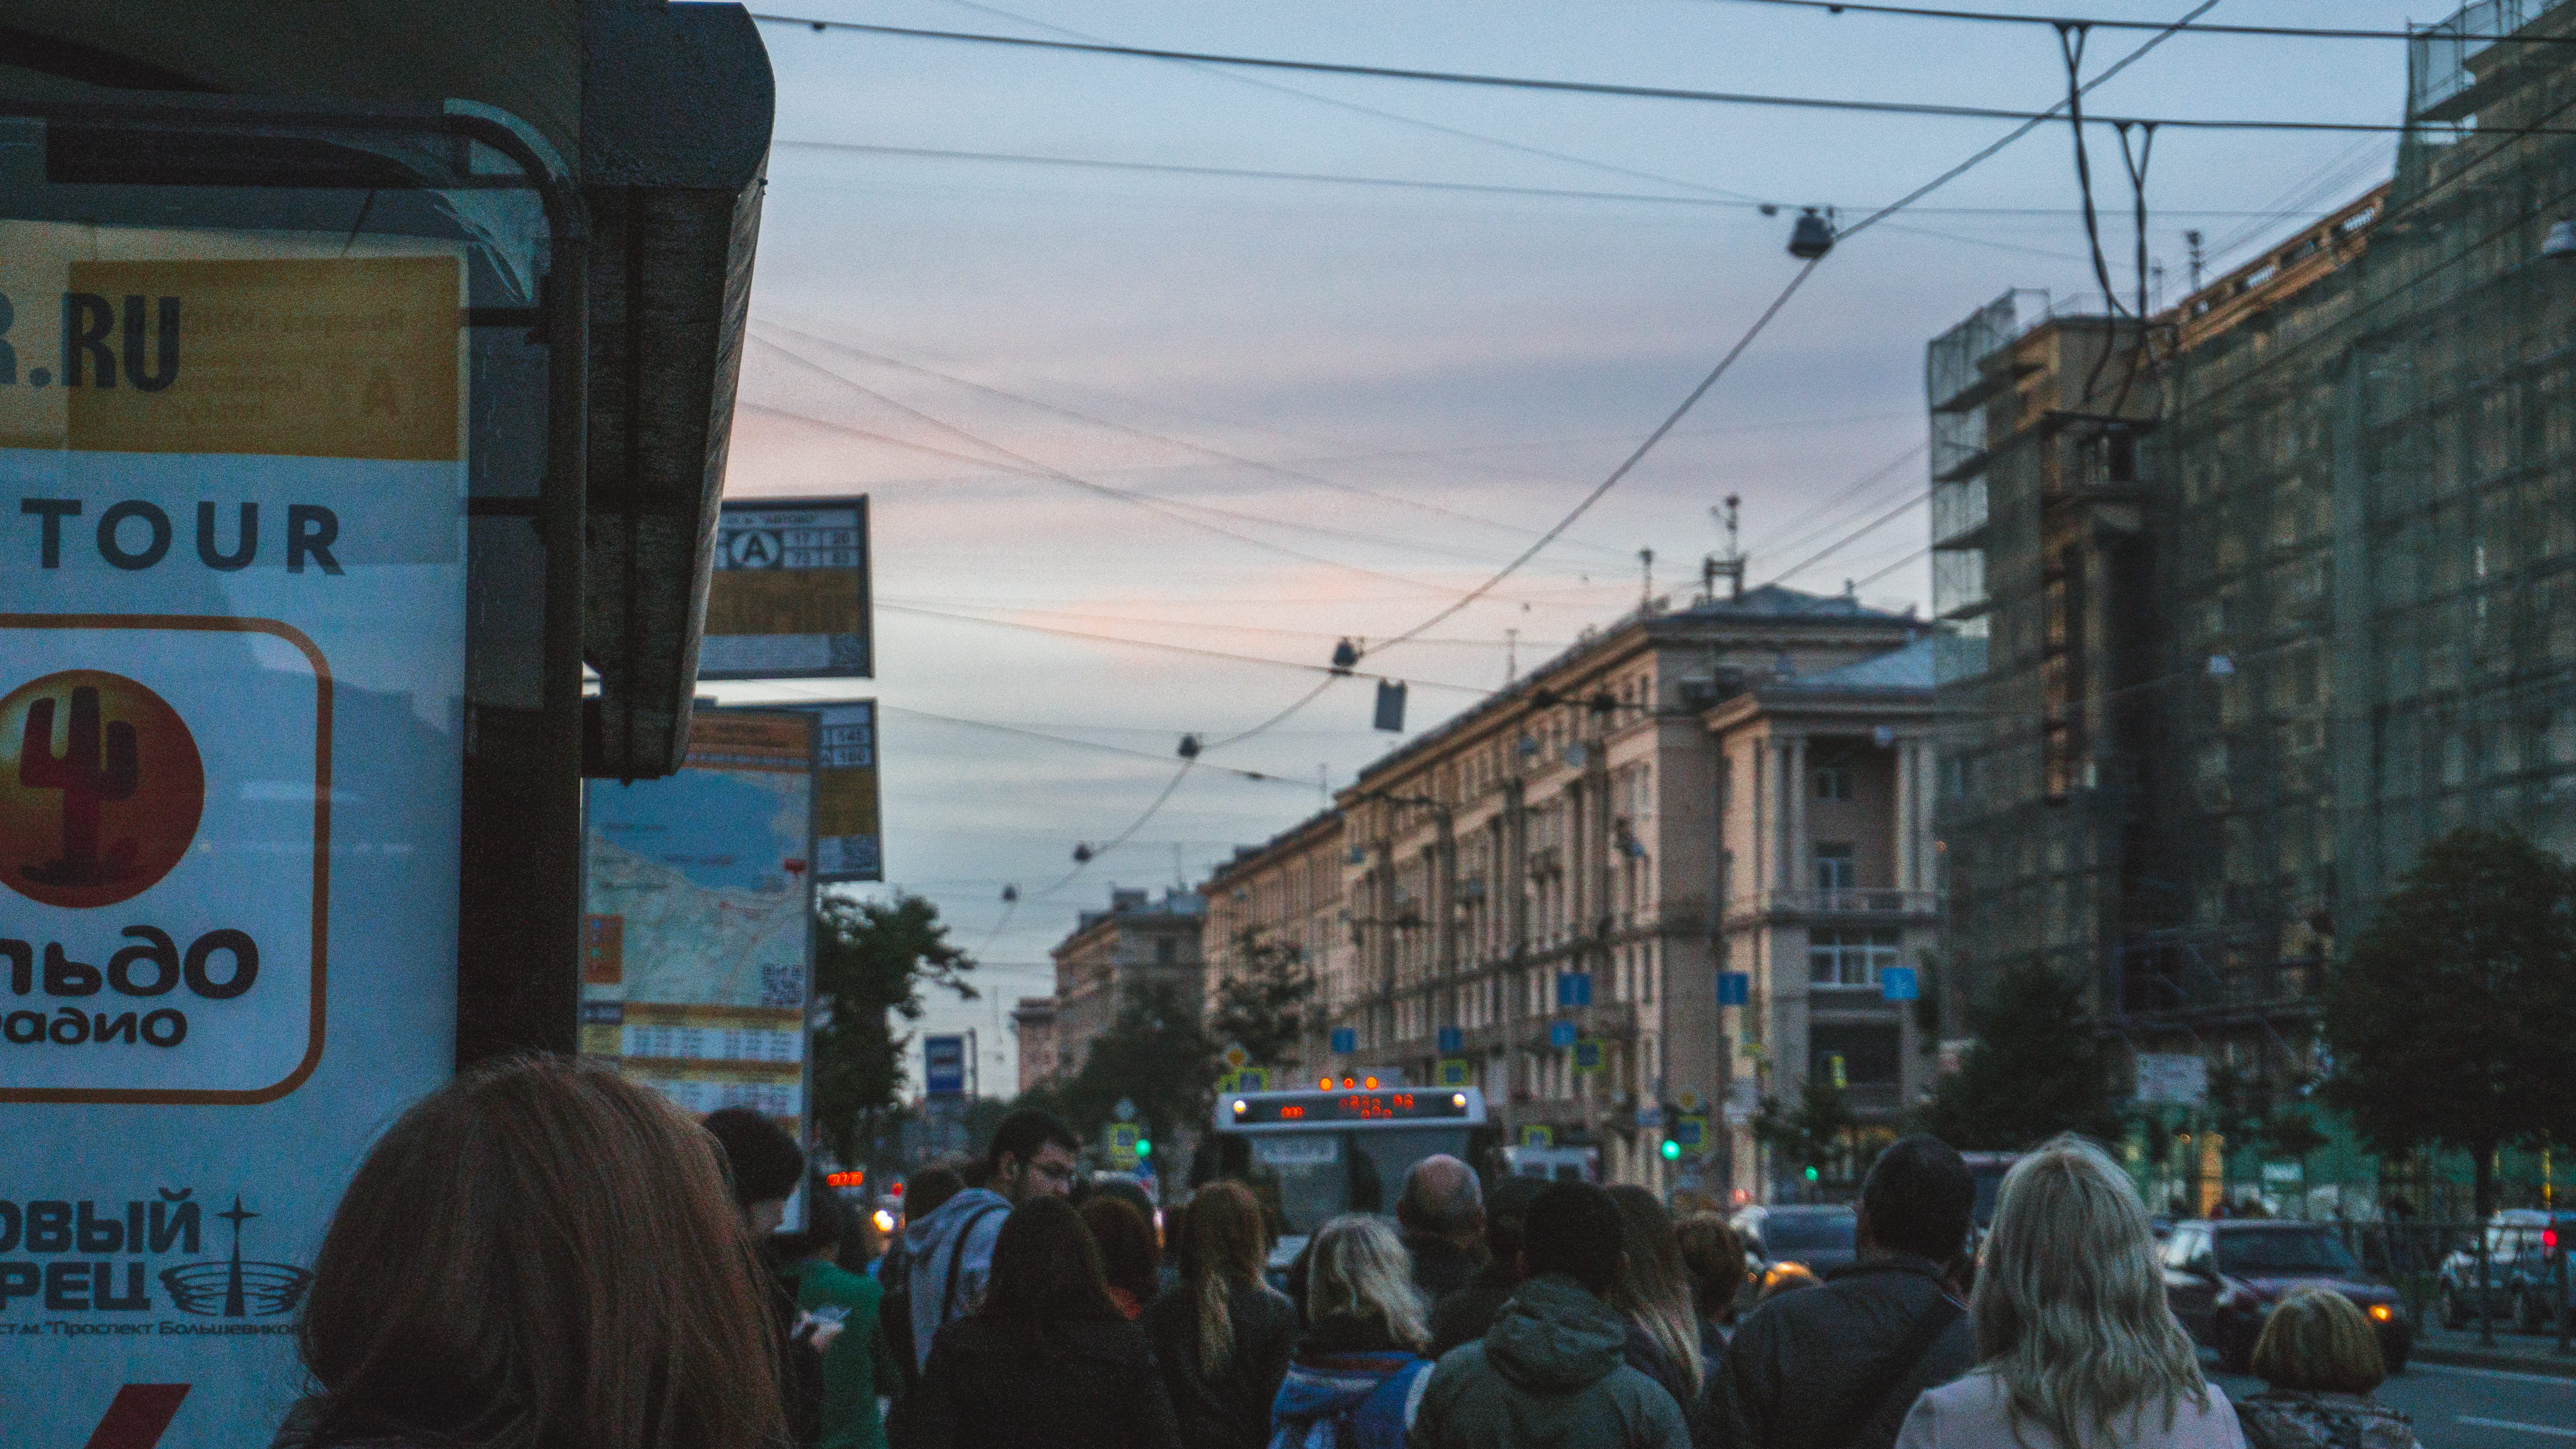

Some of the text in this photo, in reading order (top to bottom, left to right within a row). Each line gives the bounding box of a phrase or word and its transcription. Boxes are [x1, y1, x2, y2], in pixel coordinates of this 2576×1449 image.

[20, 498, 345, 575] TOUR
[0, 1007, 187, 1048] адио
[0, 1262, 151, 1310] РЕЦ
